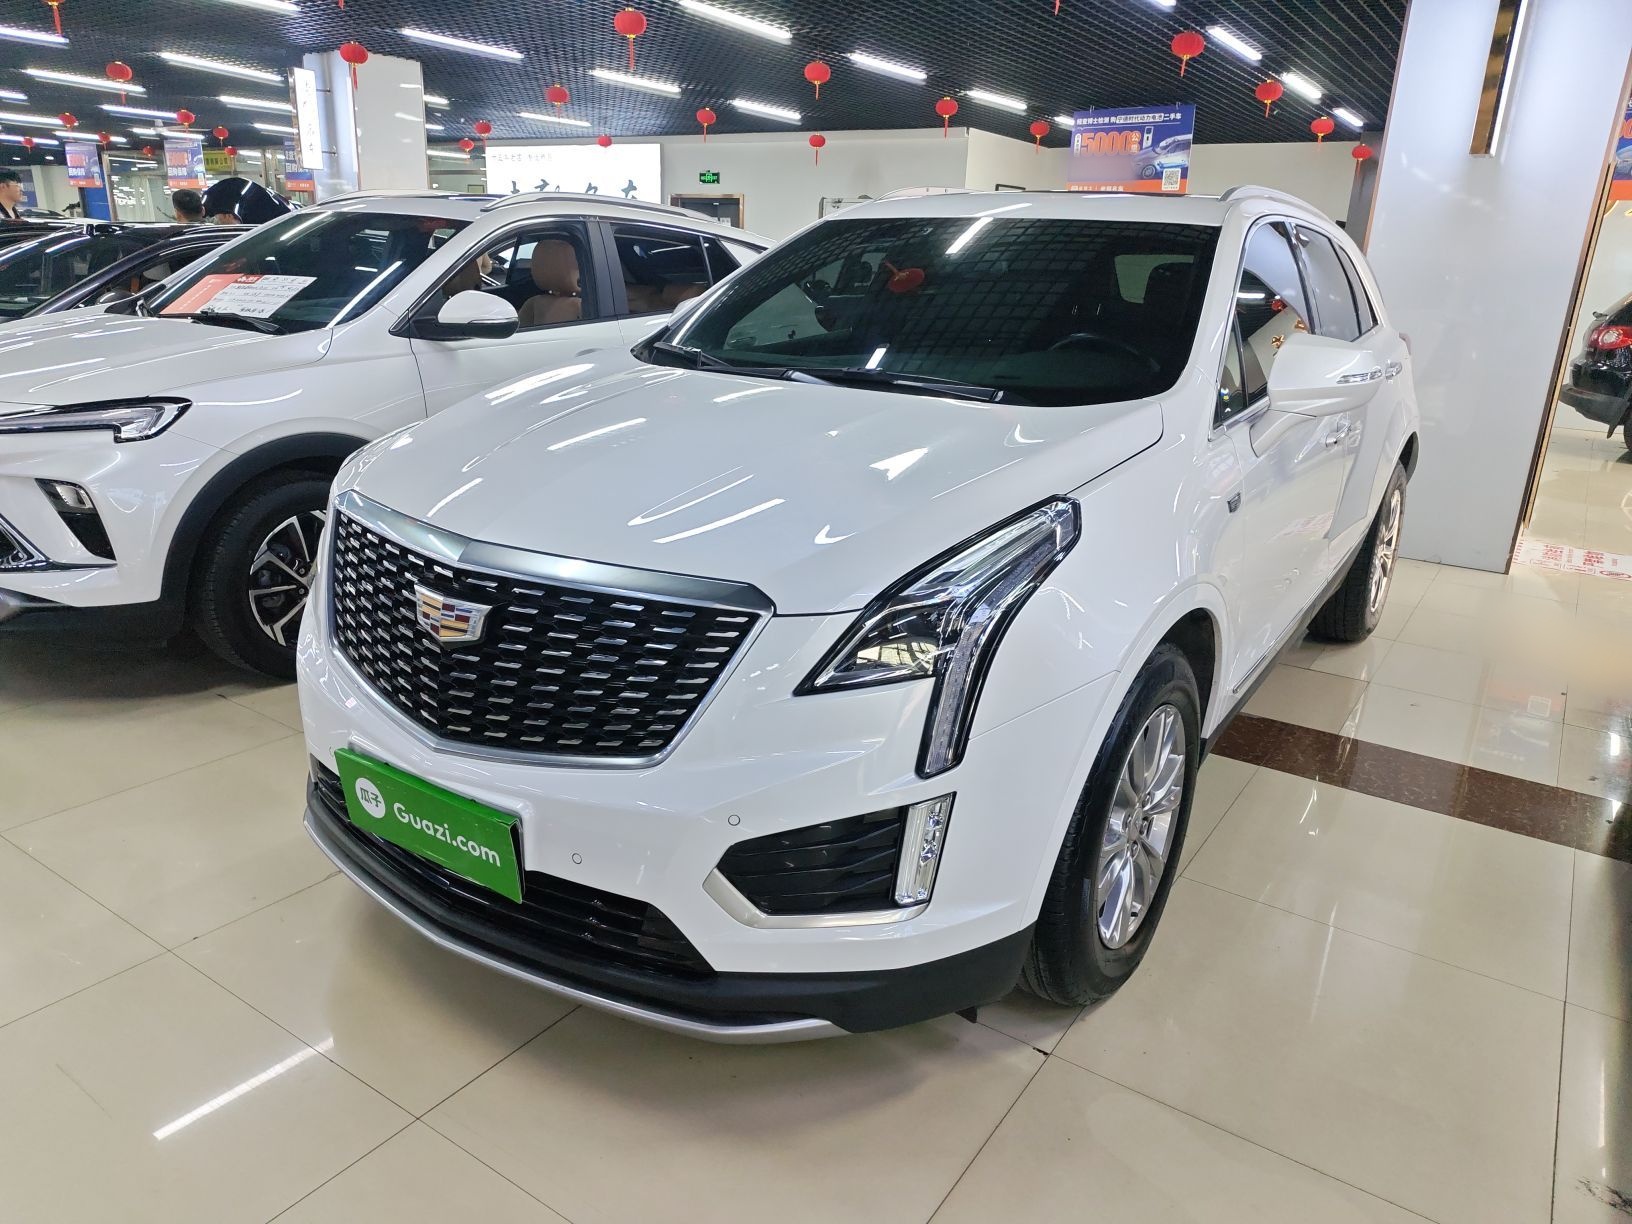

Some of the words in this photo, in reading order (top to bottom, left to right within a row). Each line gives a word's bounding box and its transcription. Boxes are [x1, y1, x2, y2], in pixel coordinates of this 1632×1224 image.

[1081, 132, 1131, 156] 5000
[360, 787, 382, 808] 瓜子
[393, 802, 501, 867] Guazi.com
